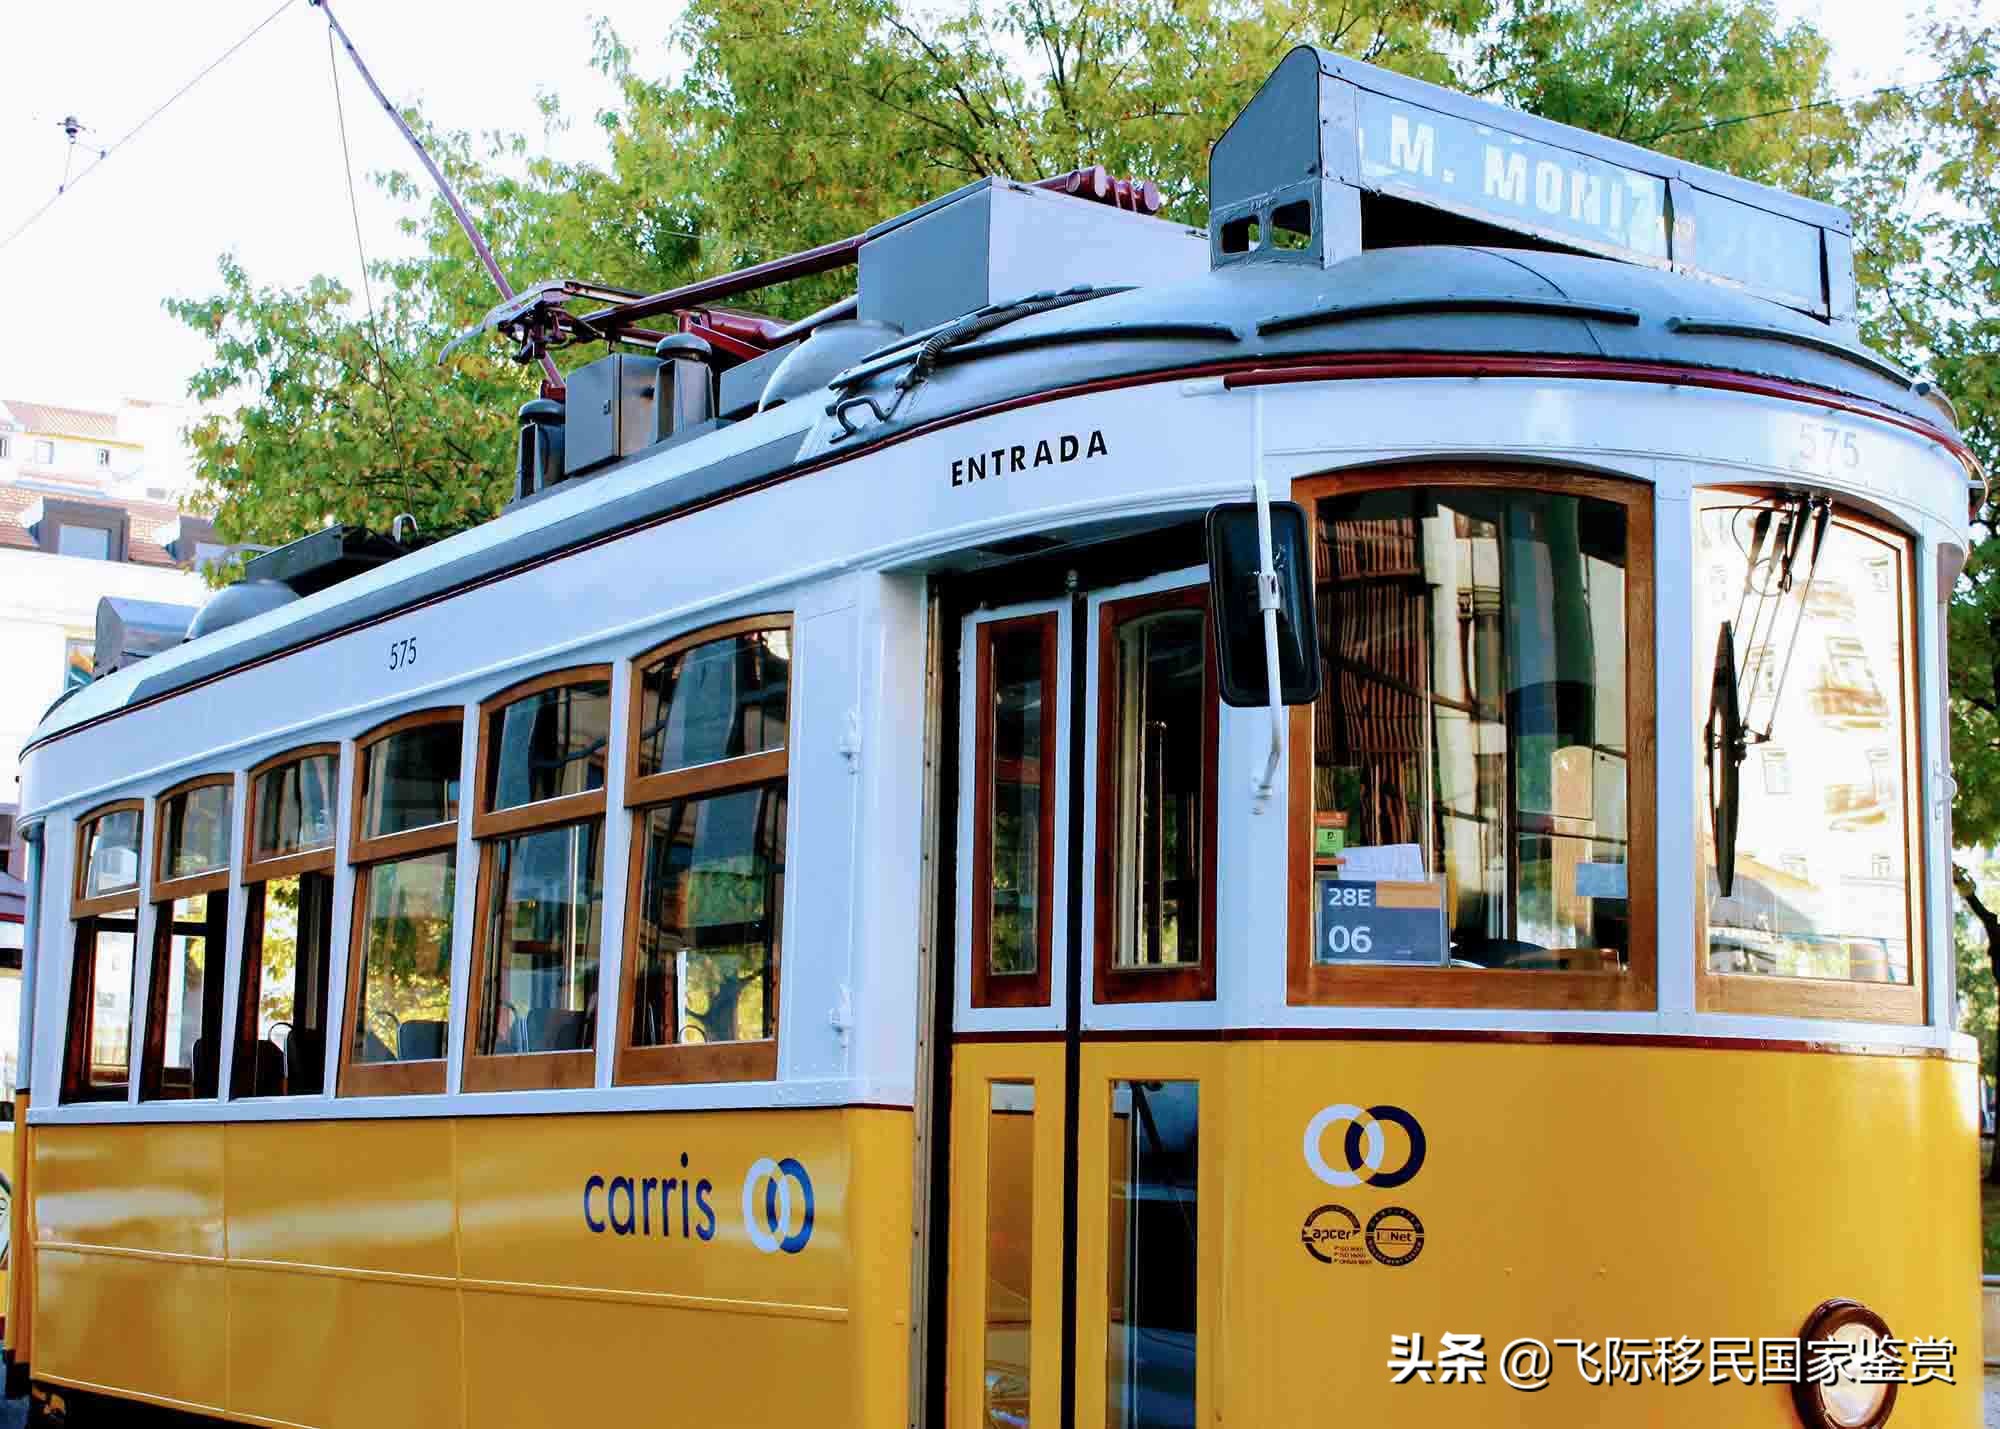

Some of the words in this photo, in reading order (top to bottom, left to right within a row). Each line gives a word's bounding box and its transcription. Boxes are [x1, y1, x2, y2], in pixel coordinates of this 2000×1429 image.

[1391, 113, 1456, 183] M.
[951, 429, 1108, 488] ENTRADA
[1799, 423, 1860, 469] 575
[389, 635, 417, 670] 575
[1327, 887, 1372, 908] 28E
[1328, 924, 1373, 954] 06
[584, 1151, 716, 1241] carris
[1312, 1228, 1352, 1243] apcer
